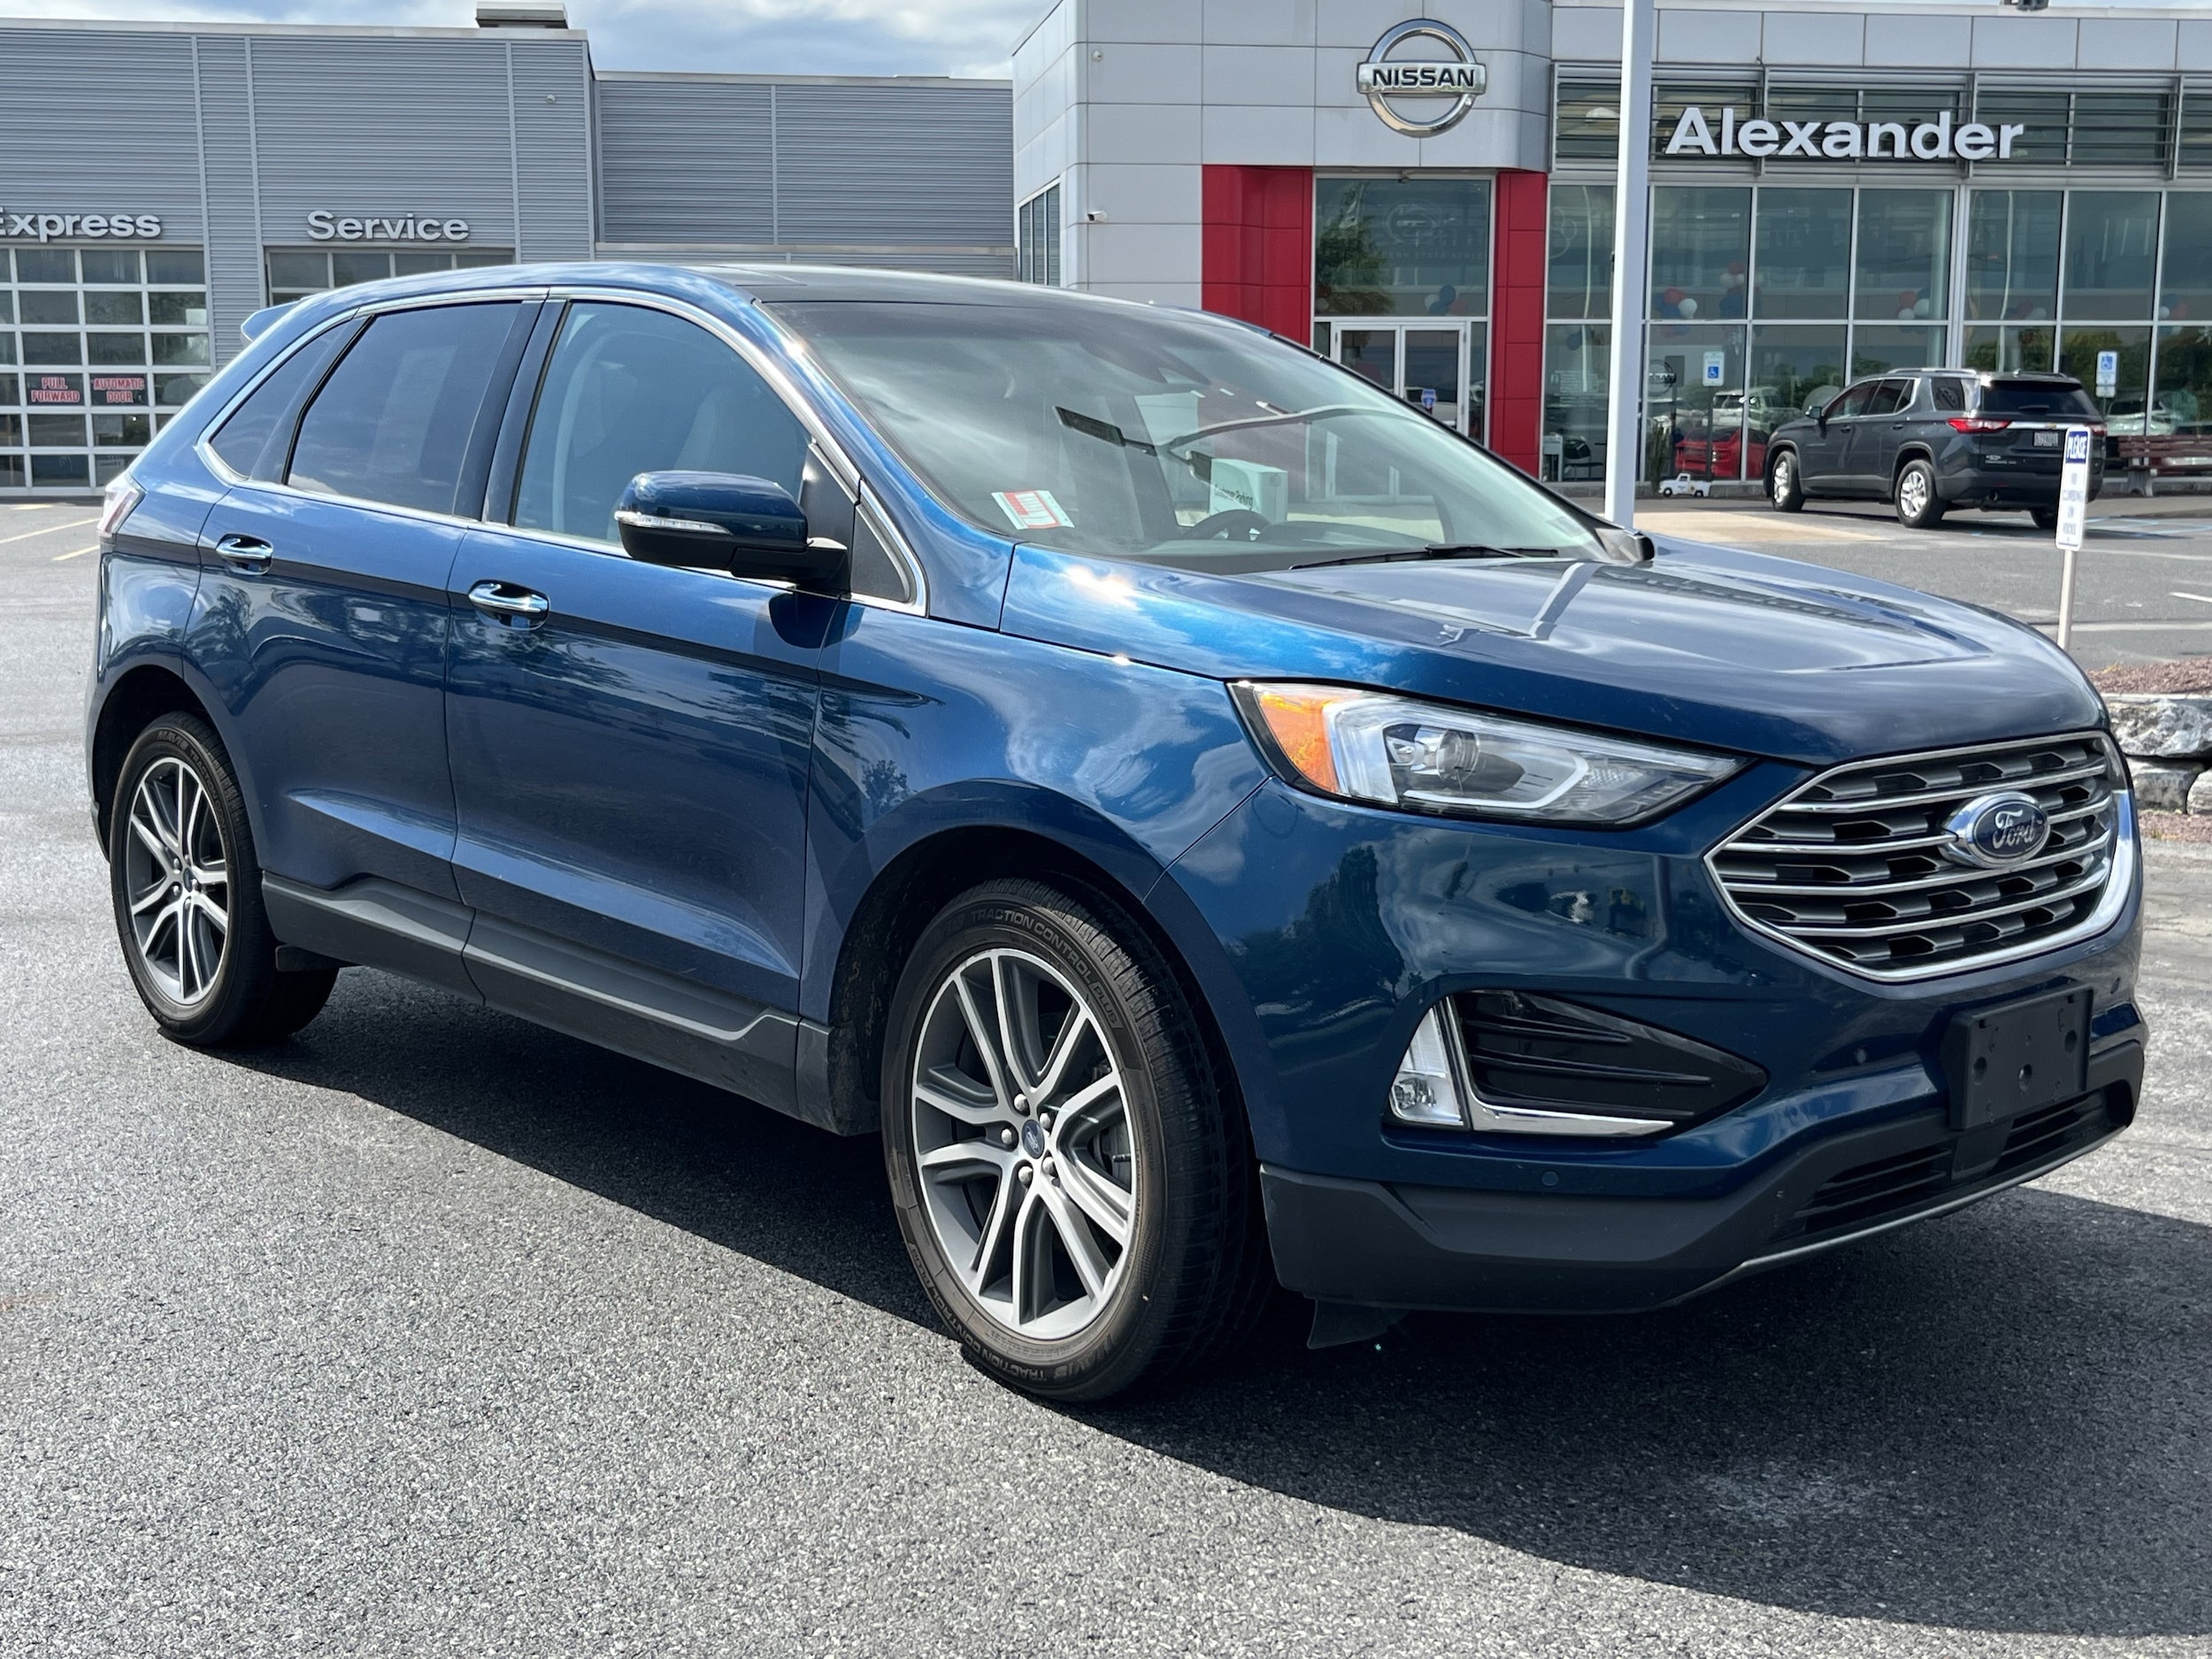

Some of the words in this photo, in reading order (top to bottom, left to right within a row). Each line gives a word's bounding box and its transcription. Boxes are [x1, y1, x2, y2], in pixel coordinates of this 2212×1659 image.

[1372, 68, 1475, 88] NISSAN
[1664, 106, 2024, 160] Alexander
[307, 210, 469, 241] Service
[42, 377, 68, 389] PULL
[93, 378, 144, 390] AUTOMATIC
[31, 390, 80, 403] FORWARD
[106, 391, 134, 403] DOOR
[2066, 434, 2087, 459] PLEASE
[1993, 810, 2035, 849] Ford
[970, 909, 1036, 930] TRACTION
[1033, 921, 1093, 984] CONTROL
[1093, 985, 1118, 1024] PLUS
